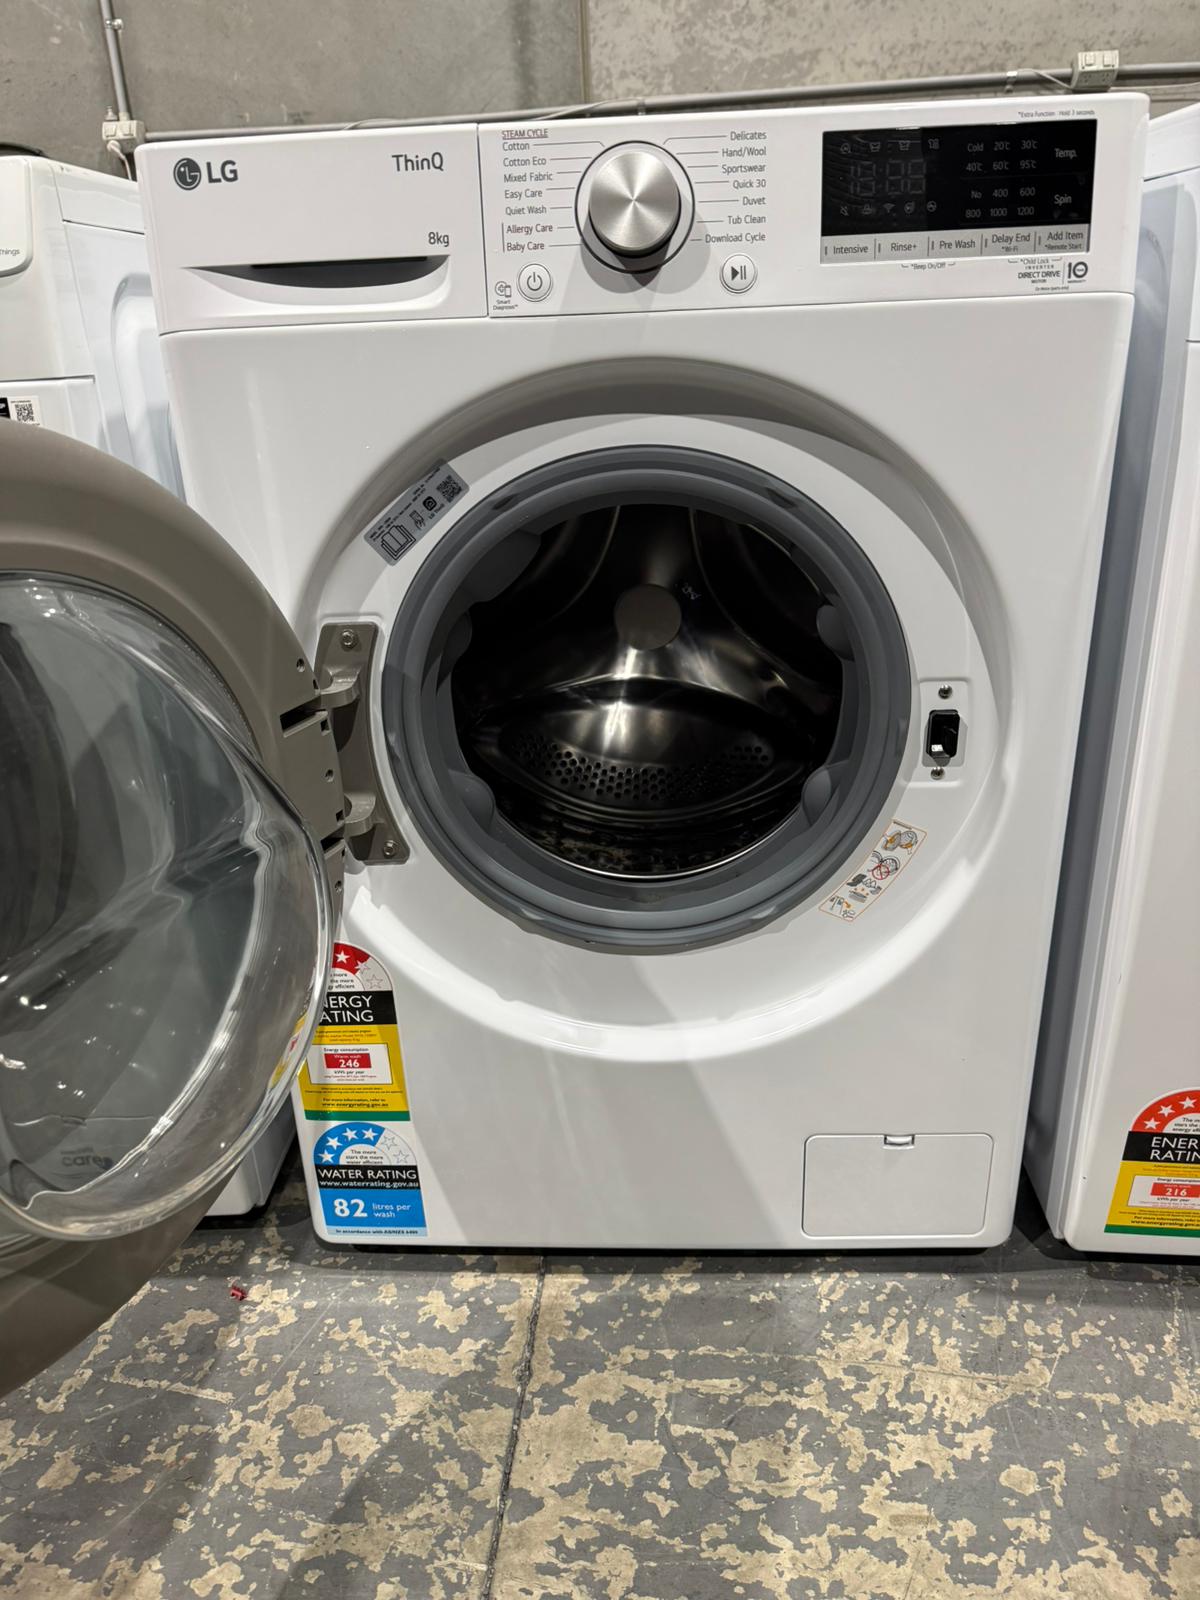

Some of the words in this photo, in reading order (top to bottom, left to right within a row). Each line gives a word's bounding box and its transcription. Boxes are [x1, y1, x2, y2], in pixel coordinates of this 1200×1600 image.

[502, 130, 525, 139] STEAM
[526, 129, 548, 138] CYCLE
[730, 130, 767, 141] Delicates
[502, 142, 530, 151] Cotton
[967, 141, 984, 151] Cold
[721, 146, 767, 158] Hand/Wool
[1054, 147, 1078, 160] Temp.
[392, 152, 444, 172] ThinQ
[503, 157, 531, 167] Cotton
[532, 156, 547, 166] Eco
[206, 160, 239, 184] LG
[721, 164, 766, 175] Sportswear
[504, 173, 527, 183] Mixed
[529, 171, 553, 182] Fabric
[732, 179, 754, 190] Quick
[755, 179, 767, 188] 30
[504, 189, 523, 200] Easy
[524, 188, 543, 198] Care
[992, 188, 1009, 198] 400
[1019, 187, 1036, 197] 600
[742, 196, 766, 206] Duvet
[1053, 194, 1072, 206] Spin
[505, 206, 527, 216] Quiet
[528, 204, 547, 214] Wash
[965, 209, 982, 219] 800
[990, 207, 1008, 217] 1000
[1017, 206, 1035, 216] 1200
[727, 215, 742, 224] Tub
[743, 214, 767, 224] Clean
[506, 224, 533, 235] Allergy
[535, 223, 553, 232] Care
[428, 231, 450, 247] 8kg
[705, 233, 742, 243] Download
[744, 232, 766, 244] Cycle
[991, 233, 1014, 245] Delay
[1015, 233, 1031, 242] End
[1047, 231, 1064, 241] Add
[1065, 231, 1084, 240] Item
[506, 242, 526, 253] Baby
[527, 241, 545, 250] Care
[890, 242, 917, 252] Rinse+
[939, 240, 953, 249] Pre
[955, 239, 976, 249] Wash
[0, 248, 20, 257] hings
[833, 245, 869, 255] Intensive
[1018, 271, 1040, 279] DIRECT
[1041, 270, 1061, 278] DRIVE
[1067, 261, 1089, 279] 10
[319, 1010, 375, 1024] ATING
[339, 1059, 360, 1069] 246
[1151, 1136, 1200, 1150] ENER
[318, 1169, 364, 1179] WATER
[367, 1169, 417, 1180] RATING
[319, 1180, 419, 1189] www.waterrating.gov.au
[1165, 1187, 1188, 1196] 216
[333, 1198, 368, 1218] 82
[395, 1204, 411, 1212] per
